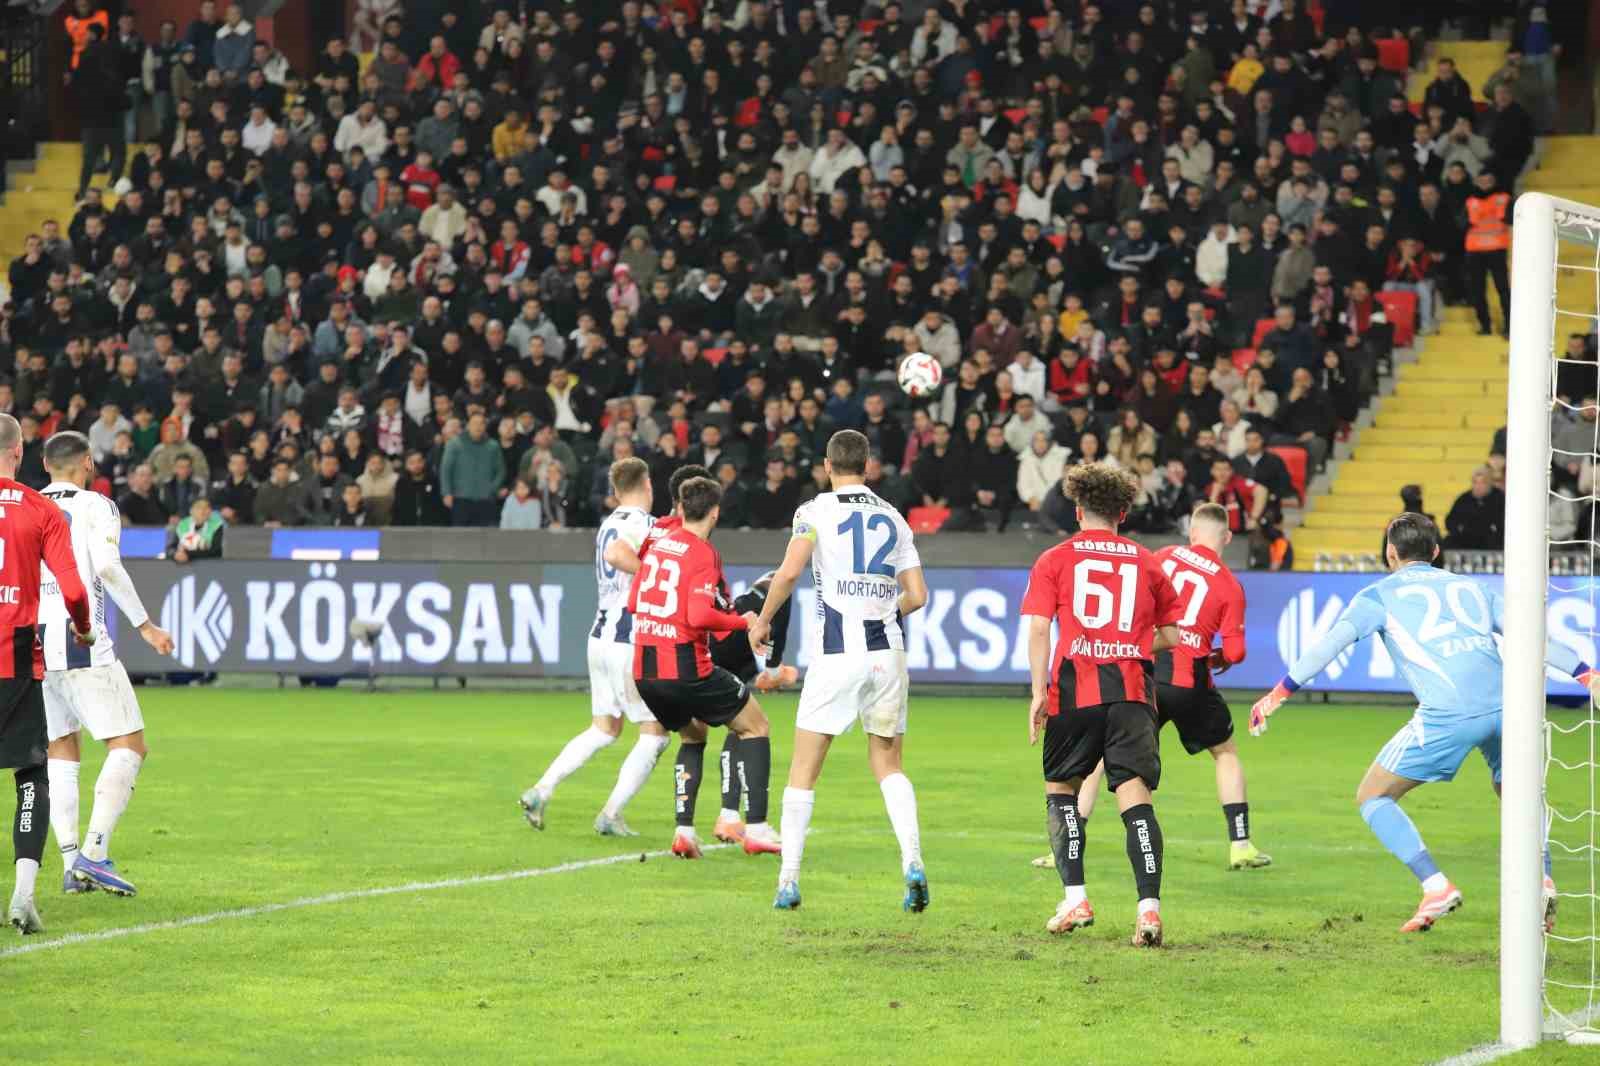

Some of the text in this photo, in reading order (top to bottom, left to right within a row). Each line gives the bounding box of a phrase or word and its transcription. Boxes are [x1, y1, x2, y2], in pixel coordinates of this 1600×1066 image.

[837, 511, 898, 577] 12
[245, 562, 564, 664] KÖKSAN
[635, 555, 681, 618] 23
[1073, 559, 1138, 632] 61
[1393, 582, 1492, 643] 20
[20, 812, 32, 832] GBB
[1132, 819, 1156, 873] GBB ENERJİ
